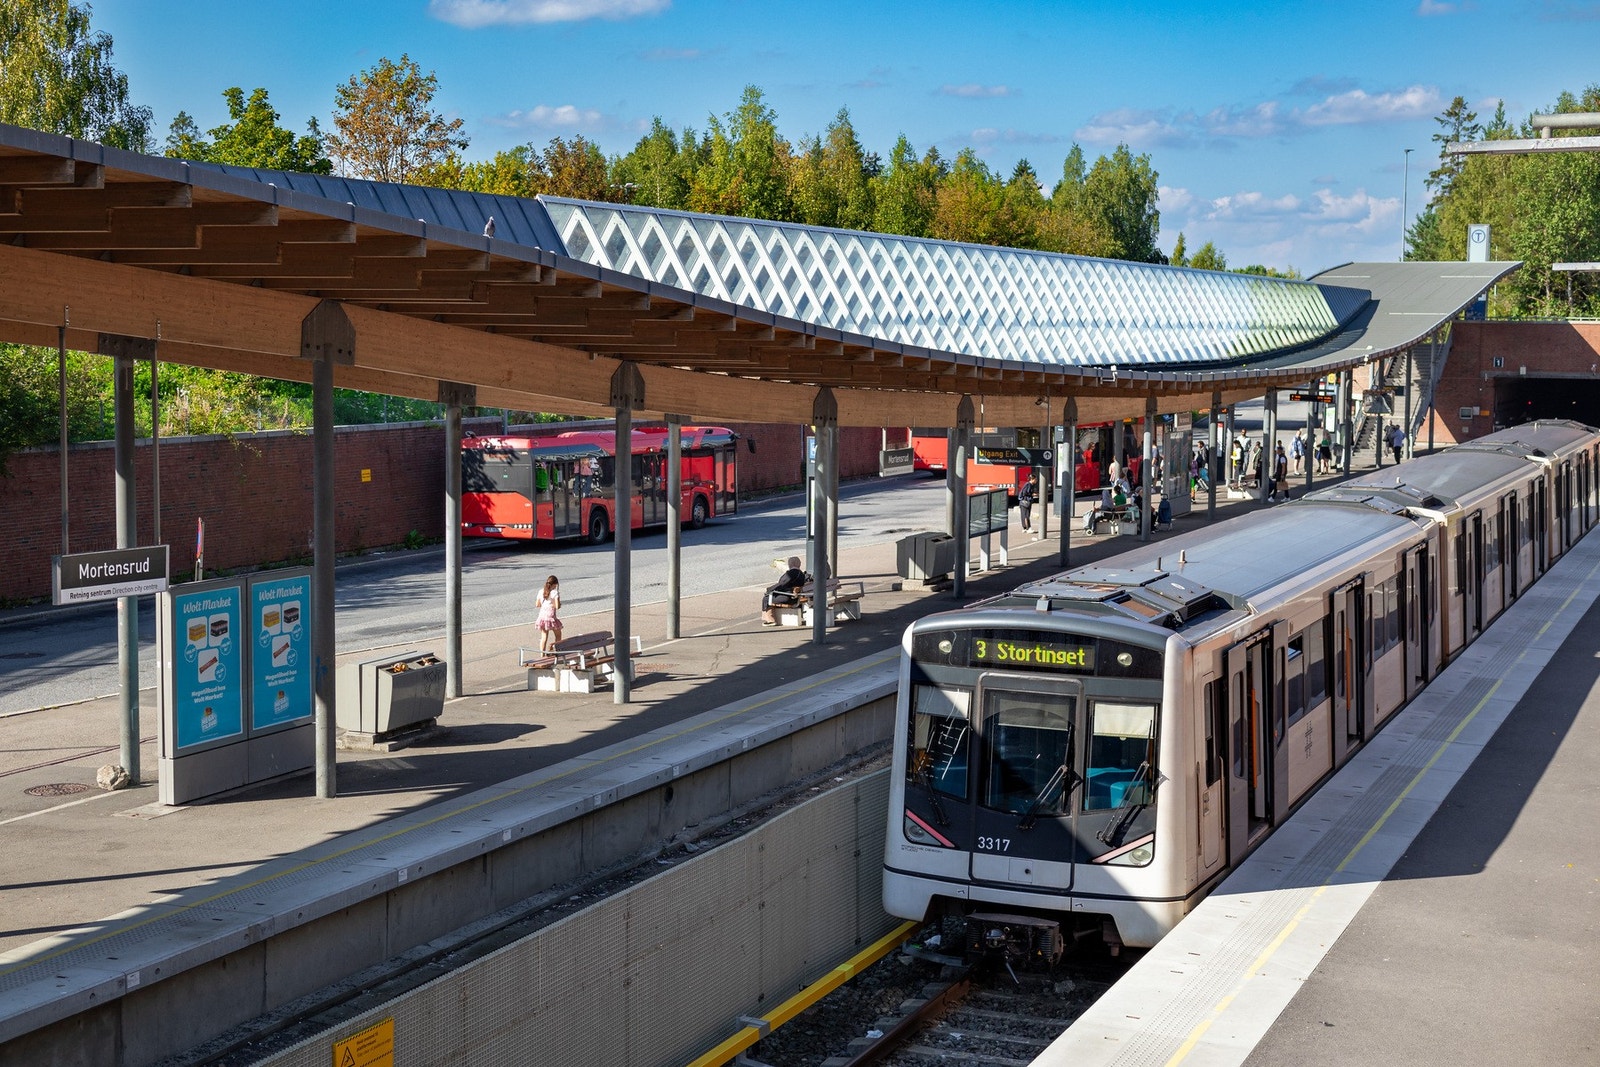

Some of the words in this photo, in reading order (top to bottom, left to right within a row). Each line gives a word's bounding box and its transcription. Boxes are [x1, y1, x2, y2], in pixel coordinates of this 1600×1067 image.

[979, 450, 1004, 459] Utgang
[1005, 450, 1018, 458] Exit
[79, 557, 150, 580] Mortensrud
[69, 591, 90, 600] Retning
[90, 588, 112, 598] sentrum
[112, 586, 134, 595] Direction
[134, 585, 143, 593] city
[143, 583, 158, 592] centre
[259, 588, 276, 601] Wolt
[276, 585, 303, 598] Market
[183, 601, 202, 614] Wolt
[202, 597, 231, 610] Market
[976, 640, 986, 658] 3
[997, 642, 1085, 666] Stortinget
[977, 836, 1011, 852] 3317
